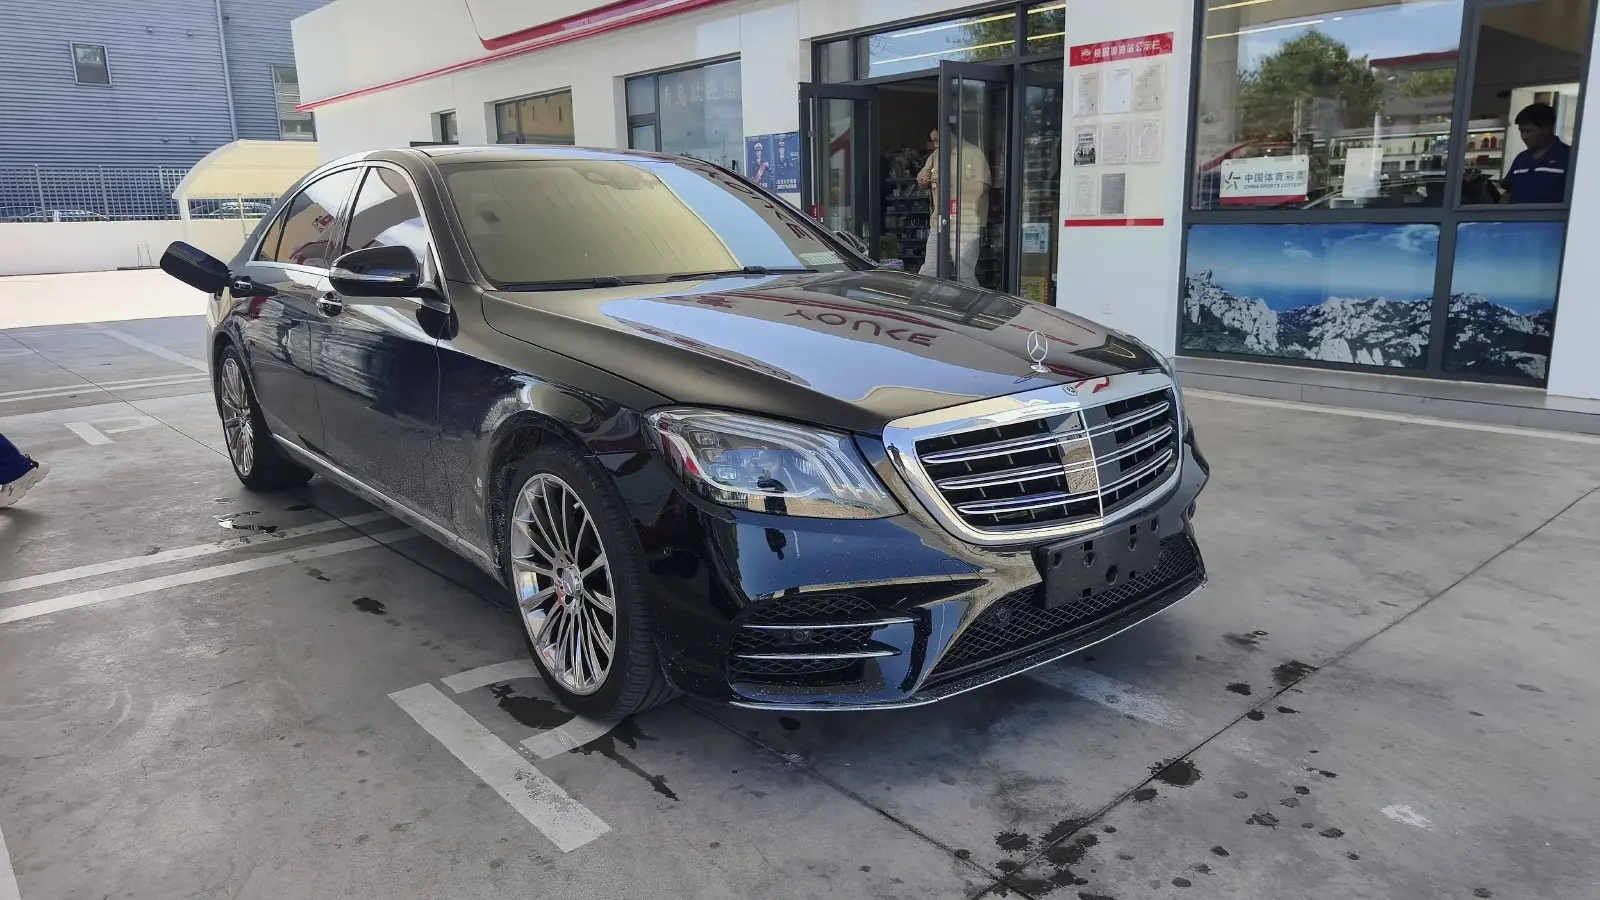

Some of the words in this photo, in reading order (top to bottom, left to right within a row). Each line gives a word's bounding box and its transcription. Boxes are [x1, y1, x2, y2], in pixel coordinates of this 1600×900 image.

[1244, 171, 1306, 183] 中国体育彩票
